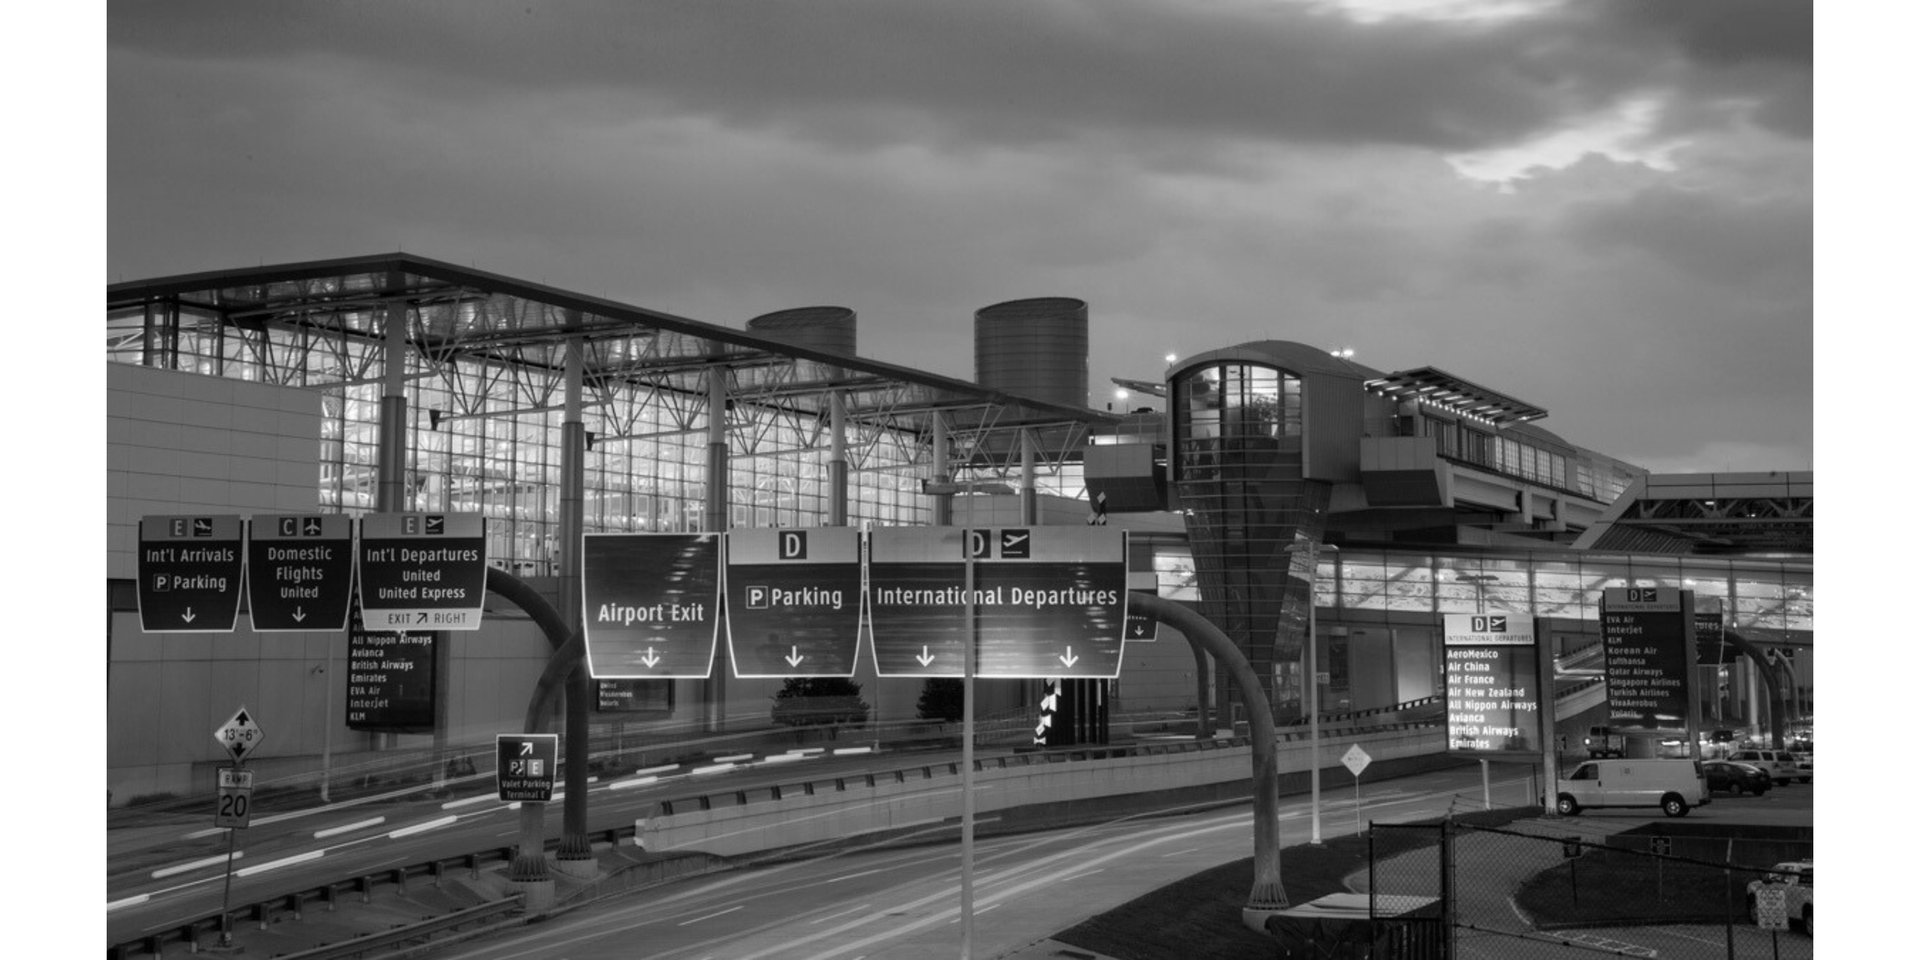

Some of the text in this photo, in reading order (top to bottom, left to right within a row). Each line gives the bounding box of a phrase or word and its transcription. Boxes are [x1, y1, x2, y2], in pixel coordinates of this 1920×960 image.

[175, 520, 183, 536] E
[283, 519, 293, 535] C
[406, 517, 414, 533] E
[785, 534, 800, 557] D
[147, 548, 234, 562] Int'l Arrivals
[268, 546, 332, 560] Domestic
[367, 548, 478, 564] Int'l Departures
[276, 566, 324, 583] Flights
[402, 569, 441, 581] United
[174, 575, 227, 592] Parking
[280, 586, 318, 598] United
[379, 587, 466, 601] United Express
[772, 587, 842, 609] Parking
[1011, 586, 1117, 609] Departures
[1630, 590, 1638, 600] D
[388, 612, 466, 624] EXIT RIGHT
[598, 603, 704, 626] Airport Exit
[1475, 618, 1484, 631] D
[1607, 626, 1642, 634] Interjet
[352, 635, 432, 646] All Nippon Airways
[352, 648, 384, 657] Avianca
[1447, 649, 1498, 659] AeroMexico
[1608, 647, 1657, 655] Korean Air
[351, 660, 414, 671] British Airways
[1448, 662, 1490, 671] Air China
[351, 673, 387, 683] Emirates
[1633, 668, 1663, 677] Airways
[1448, 675, 1494, 684] Air France
[1610, 679, 1648, 687] Singapore
[350, 686, 380, 695] EVA Air
[1448, 688, 1525, 697] Air New Zealand
[350, 697, 388, 709] Interjet
[1449, 700, 1537, 712] All Nippon Airways
[350, 712, 366, 720] KLM
[1449, 713, 1485, 722] Avianca
[1449, 725, 1519, 737] British Airways
[1450, 738, 1490, 748] Emirates
[532, 761, 539, 775] E
[501, 780, 551, 790] Valet Parking
[220, 794, 247, 817] 20
